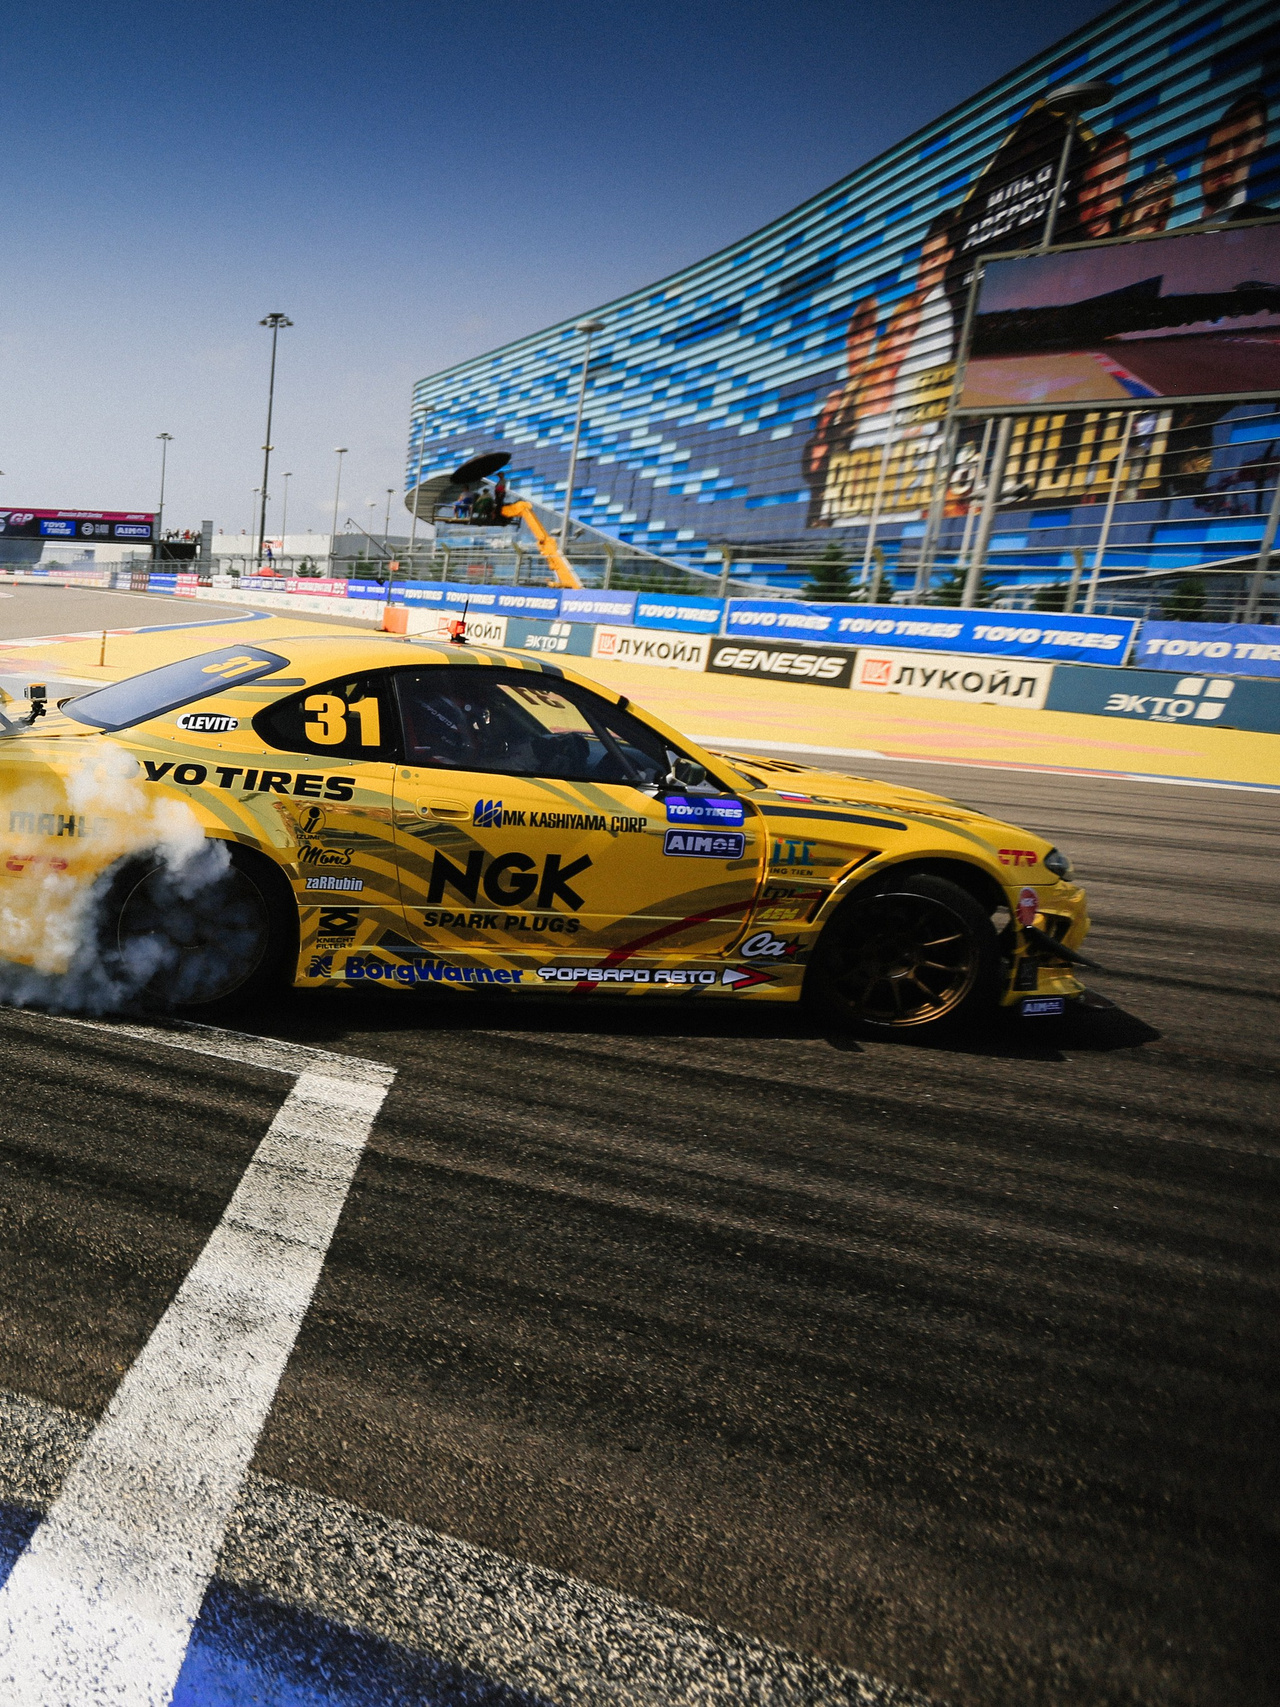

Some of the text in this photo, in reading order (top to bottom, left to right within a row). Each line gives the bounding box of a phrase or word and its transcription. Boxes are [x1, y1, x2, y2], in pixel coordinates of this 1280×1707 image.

[10, 512, 34, 524] GP
[562, 600, 633, 616] TOYO TIRES
[639, 603, 720, 623] TOYO TIRES
[466, 621, 502, 640] КОЙЛ
[730, 611, 833, 631] TOYO TIRES
[838, 616, 964, 639] TOYO TIRES
[973, 625, 1124, 650] TOYO TIRES
[617, 639, 702, 663] ЛУКОЙЛ
[1146, 639, 1280, 662] TOYO TIR
[712, 646, 847, 679] GENESIS
[894, 666, 1038, 698] ЛУКОЙЛ
[1103, 693, 1195, 717] ЭКТО
[176, 713, 239, 731] CLEVITE
[304, 694, 381, 747] 31
[141, 760, 356, 802] YO TIRES
[502, 810, 647, 834] MK KASHIYAMA CORP.
[669, 805, 743, 818] TOYO TIRES
[667, 835, 740, 854] AIMOL
[306, 876, 363, 891] zaRRubin
[426, 849, 593, 912] NGK
[423, 911, 581, 934] SPARK PLUGS
[344, 956, 524, 985] BorgWarner
[537, 966, 716, 984] ФОРВАРД АВТО
